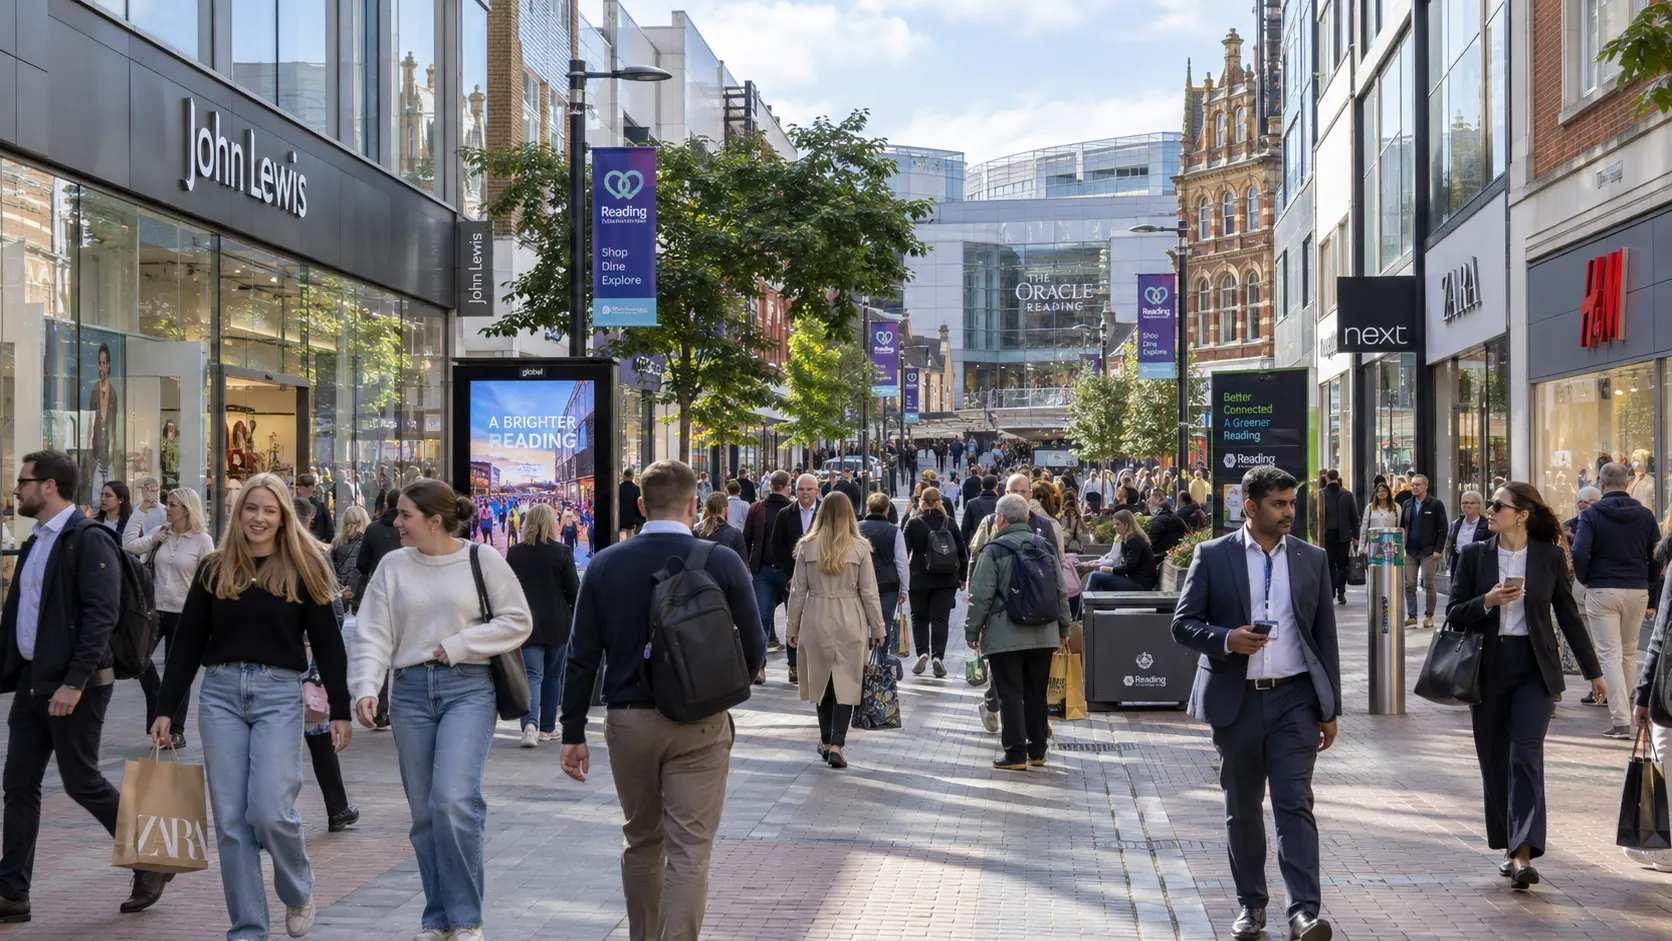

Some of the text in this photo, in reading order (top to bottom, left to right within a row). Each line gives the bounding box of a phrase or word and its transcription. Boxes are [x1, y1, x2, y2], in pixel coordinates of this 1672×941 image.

[181, 97, 307, 218] John Lewis
[601, 205, 647, 219] Reading
[601, 247, 628, 259] Shop
[468, 233, 487, 305] John Lewis
[601, 261, 626, 271] Dine
[602, 275, 642, 287] Explore
[1027, 273, 1051, 283] THE
[1015, 282, 1094, 301] ORACLE
[1441, 255, 1483, 323] ZARA
[1579, 247, 1631, 349] H&M
[1027, 301, 1084, 312] READING
[1142, 307, 1171, 316] Reading
[1344, 325, 1408, 345] next
[1223, 392, 1252, 402] Better
[1223, 404, 1273, 415] Connected
[488, 416, 577, 429] A BRIGHTER
[1223, 418, 1271, 428] A Greener
[489, 433, 577, 449] READING
[1223, 430, 1261, 443] Reading
[1237, 453, 1276, 467] Reading
[1135, 675, 1167, 688] Reading
[138, 814, 208, 861] ZARA
